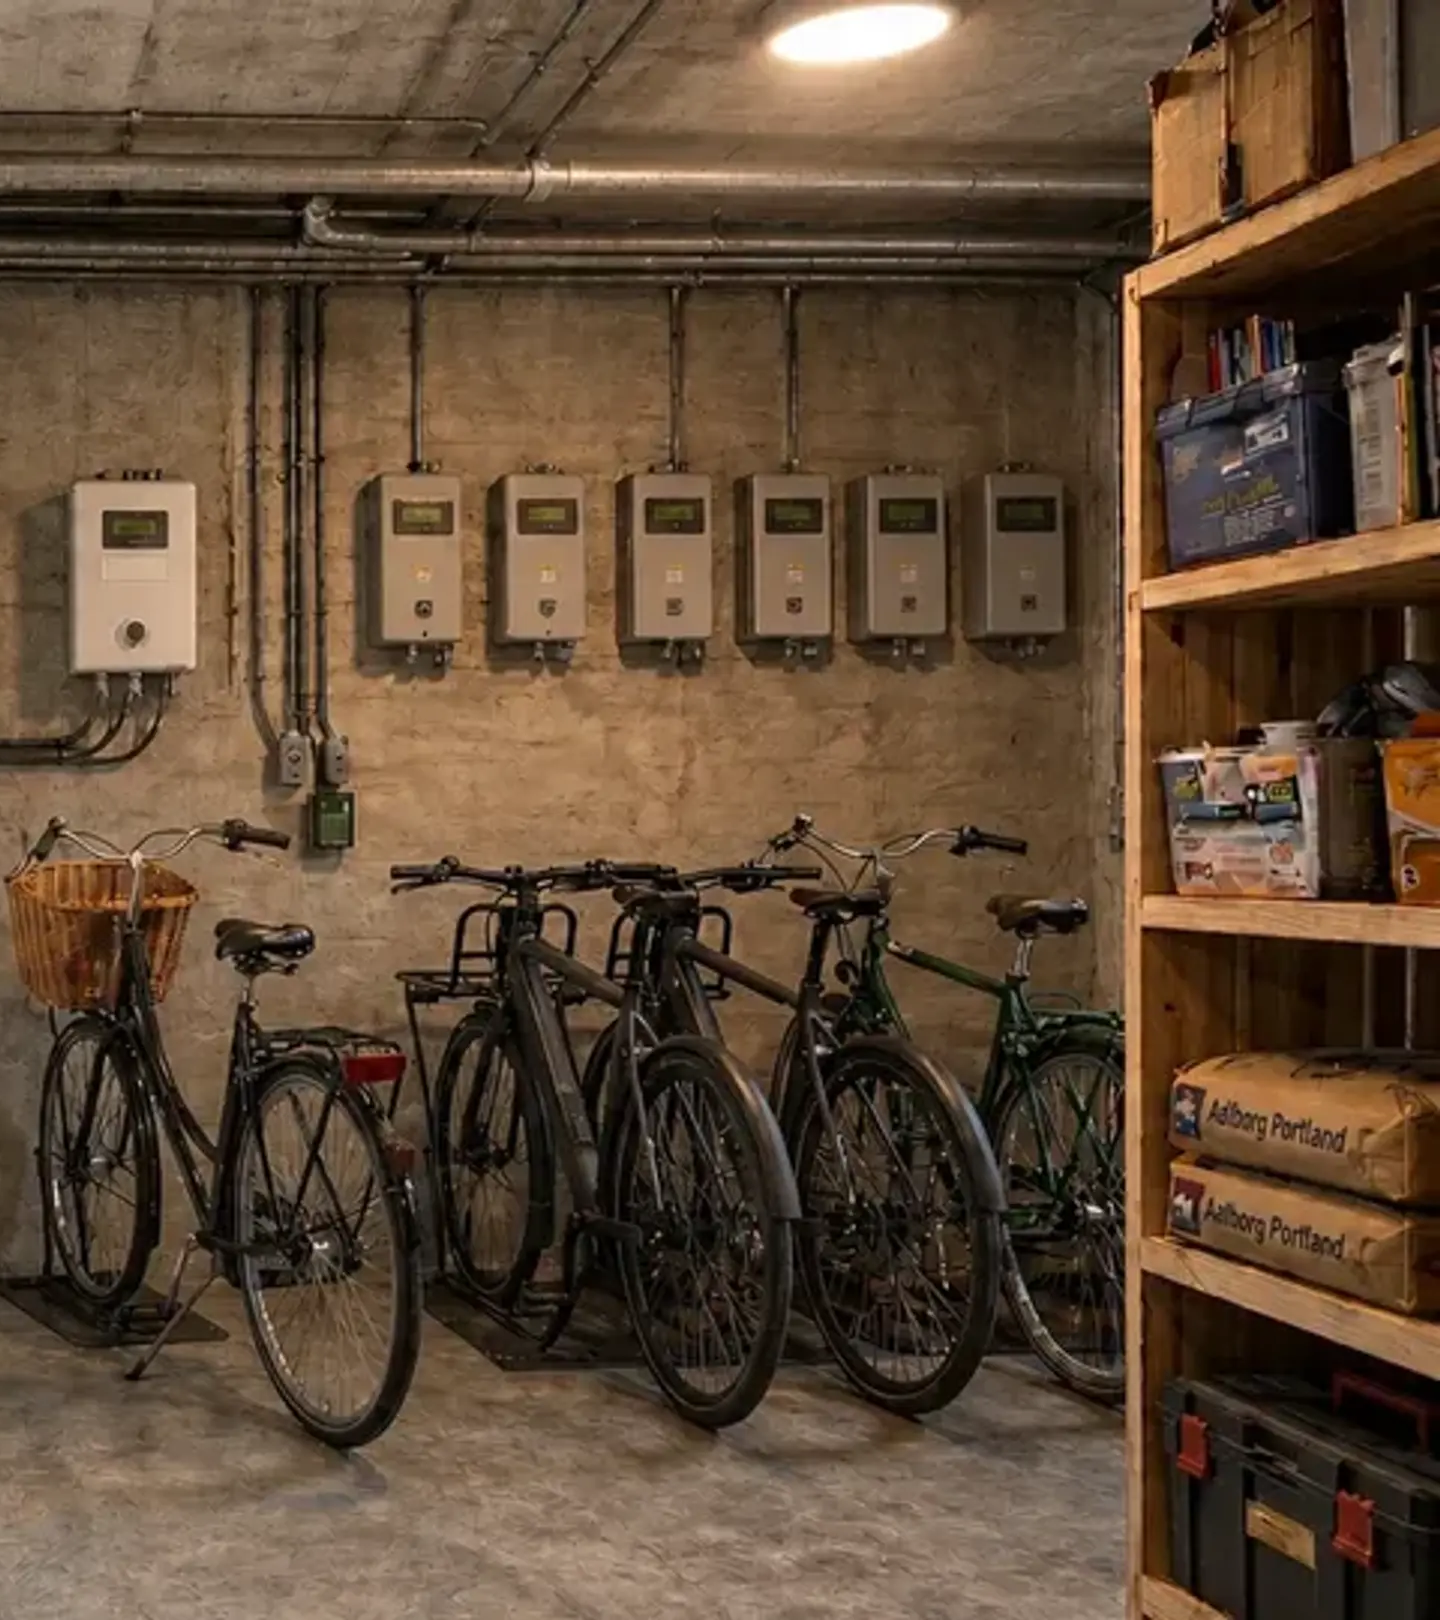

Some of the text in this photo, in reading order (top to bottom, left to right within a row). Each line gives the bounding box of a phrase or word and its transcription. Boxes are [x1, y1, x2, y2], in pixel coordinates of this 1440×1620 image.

[1206, 1098, 1347, 1153] Aalborg Portland
[1203, 1197, 1345, 1259] Aalborg Portland
